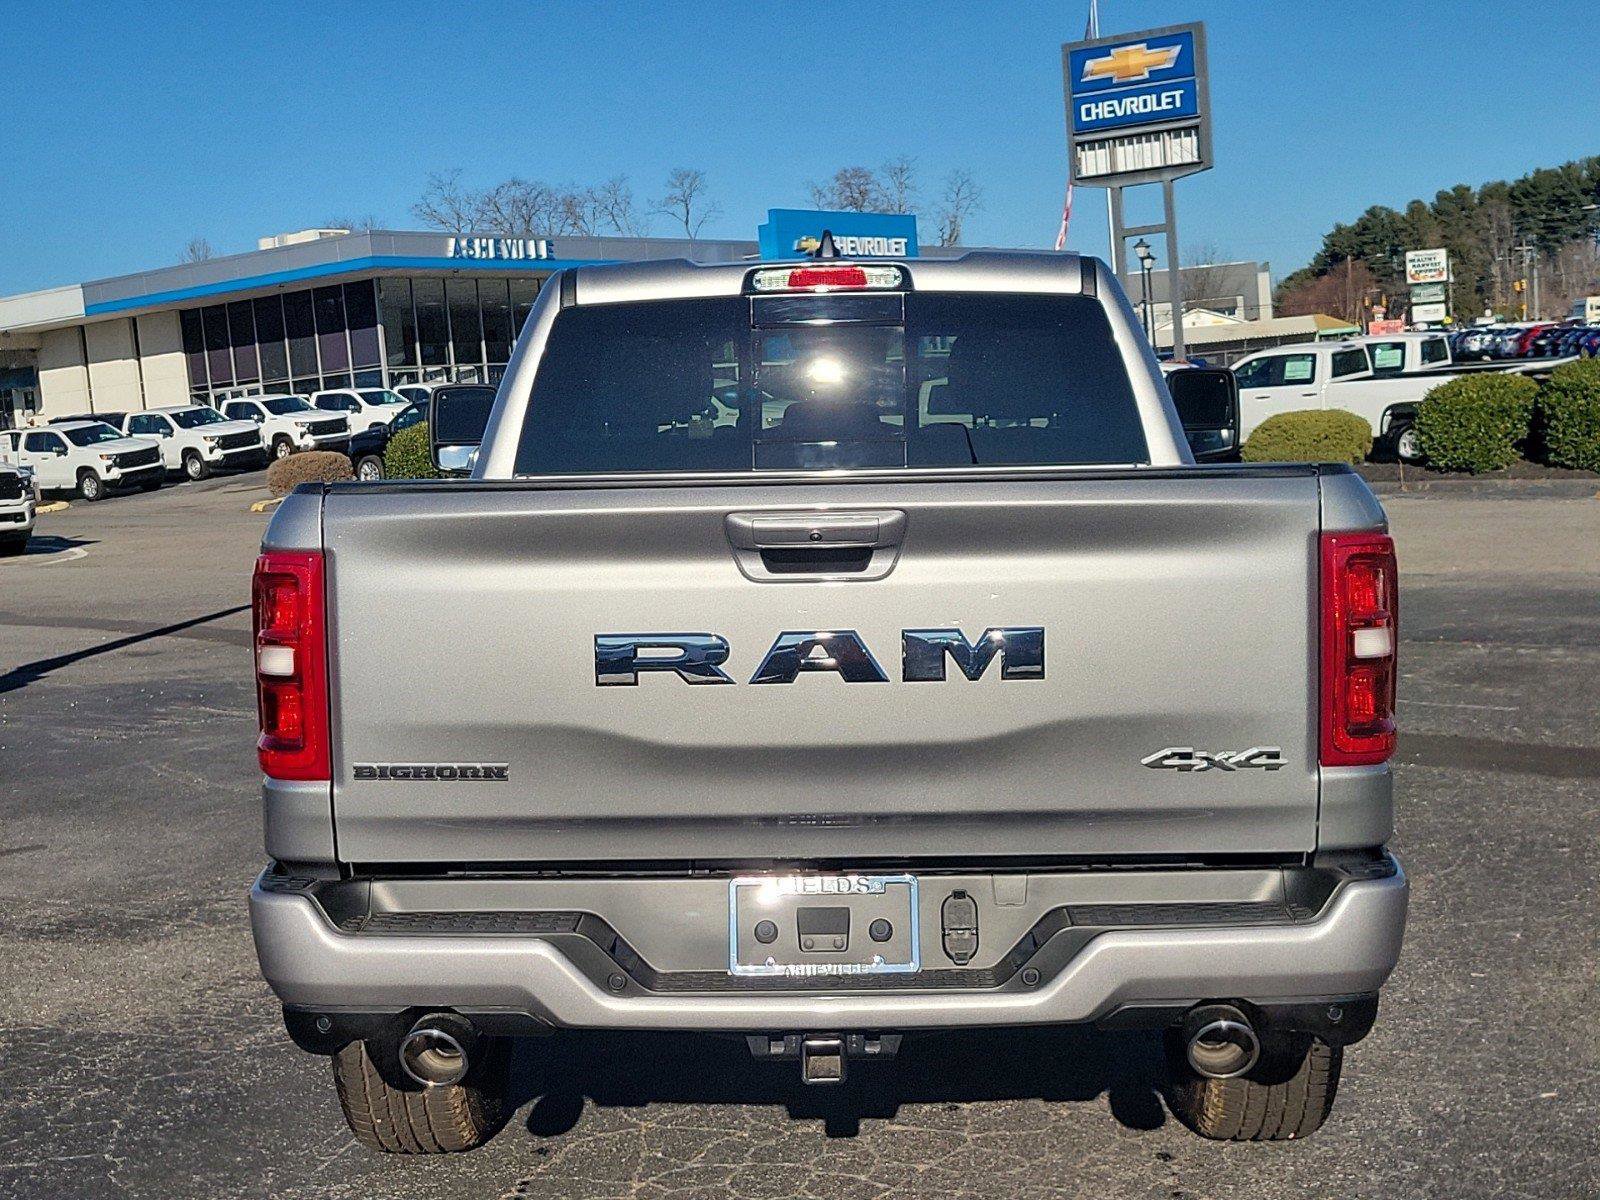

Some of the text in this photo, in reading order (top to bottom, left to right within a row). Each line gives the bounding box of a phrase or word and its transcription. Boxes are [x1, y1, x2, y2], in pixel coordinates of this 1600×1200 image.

[1080, 89, 1184, 122] CHEVROLET
[446, 237, 556, 261] ASHEVILLE
[833, 236, 908, 257] HEVROLET
[593, 626, 1046, 687] RAM
[352, 761, 510, 782] BIGHORN
[776, 876, 870, 894] IELDS
